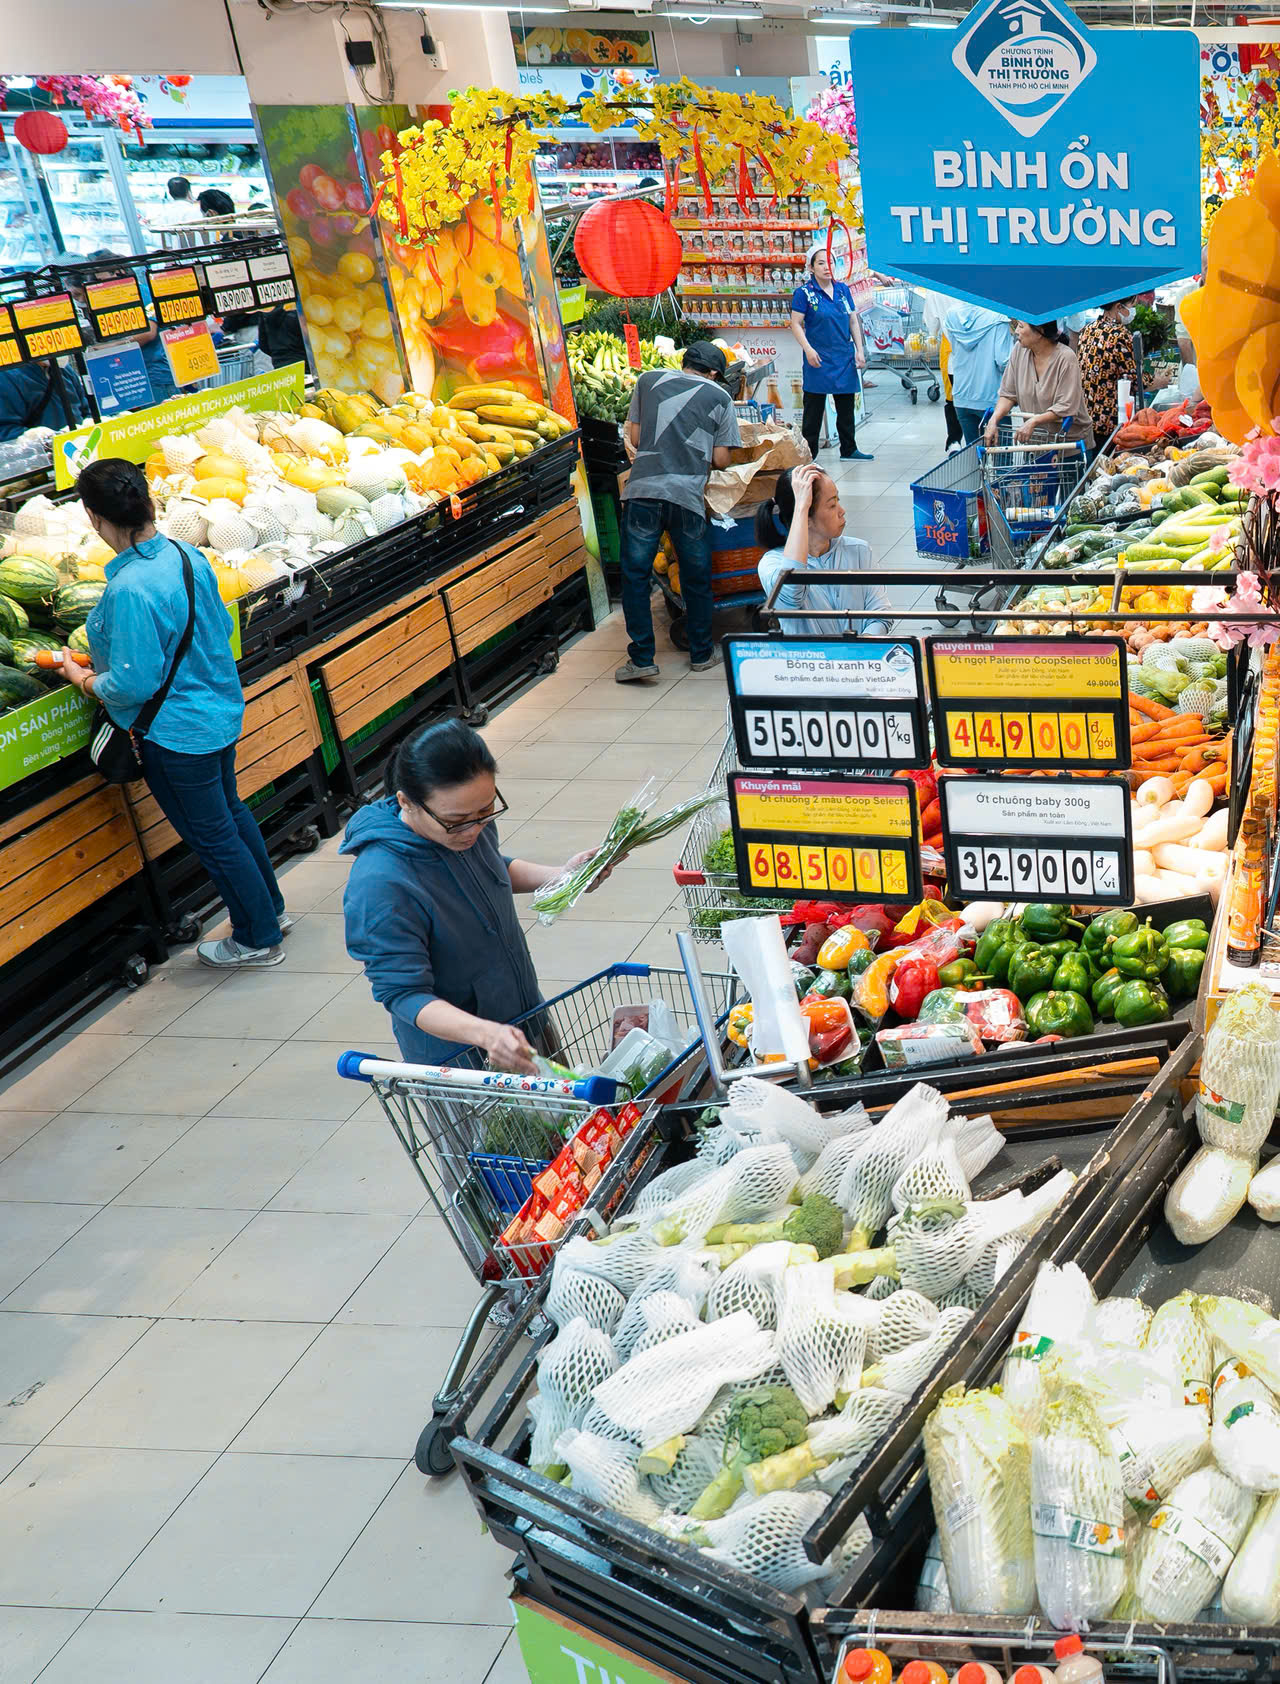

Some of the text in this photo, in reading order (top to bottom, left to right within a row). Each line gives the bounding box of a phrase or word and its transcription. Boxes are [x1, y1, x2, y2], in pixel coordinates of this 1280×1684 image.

[1034, 47, 1053, 55] TRÌNH
[1001, 54, 1054, 68] BÌNH ỔN
[988, 67, 1070, 82] THỊ TRƯỜNG
[933, 134, 1129, 191] BÌNH ỔN
[890, 198, 1177, 254] THỊ TRƯỜNG
[750, 347, 777, 356] RANG
[109, 428, 126, 442] TIN
[127, 419, 154, 437] CHỌN
[156, 412, 173, 429] SẢN
[175, 403, 200, 421] PHẨM
[201, 398, 221, 416] TÍCH
[222, 391, 246, 407] XANH
[247, 381, 272, 398] TRÁCH
[273, 373, 297, 391] NHIỆM
[922, 525, 959, 547] Tiger
[838, 660, 865, 670] xanh
[867, 660, 882, 672] kg
[989, 656, 1031, 665] Palermo
[1033, 657, 1091, 667] CoopSelect
[1094, 657, 1118, 667] 300g
[865, 675, 897, 683] VietGAP
[19, 711, 49, 737] SẢN
[754, 715, 879, 749] 55.000
[954, 718, 1081, 752] 44.900
[740, 780, 801, 793] Khuyến mãi
[812, 795, 819, 804] 2
[845, 796, 871, 807] Coop
[873, 796, 903, 806] Select
[976, 792, 1091, 809] Ớt chuông baby 300g
[1001, 809, 1016, 817] Sản
[1017, 809, 1037, 819] phẩm
[1049, 811, 1066, 819] toàn
[754, 848, 875, 882] 68.500
[963, 850, 1088, 886] 32.900
[560, 1644, 625, 1684] TI
